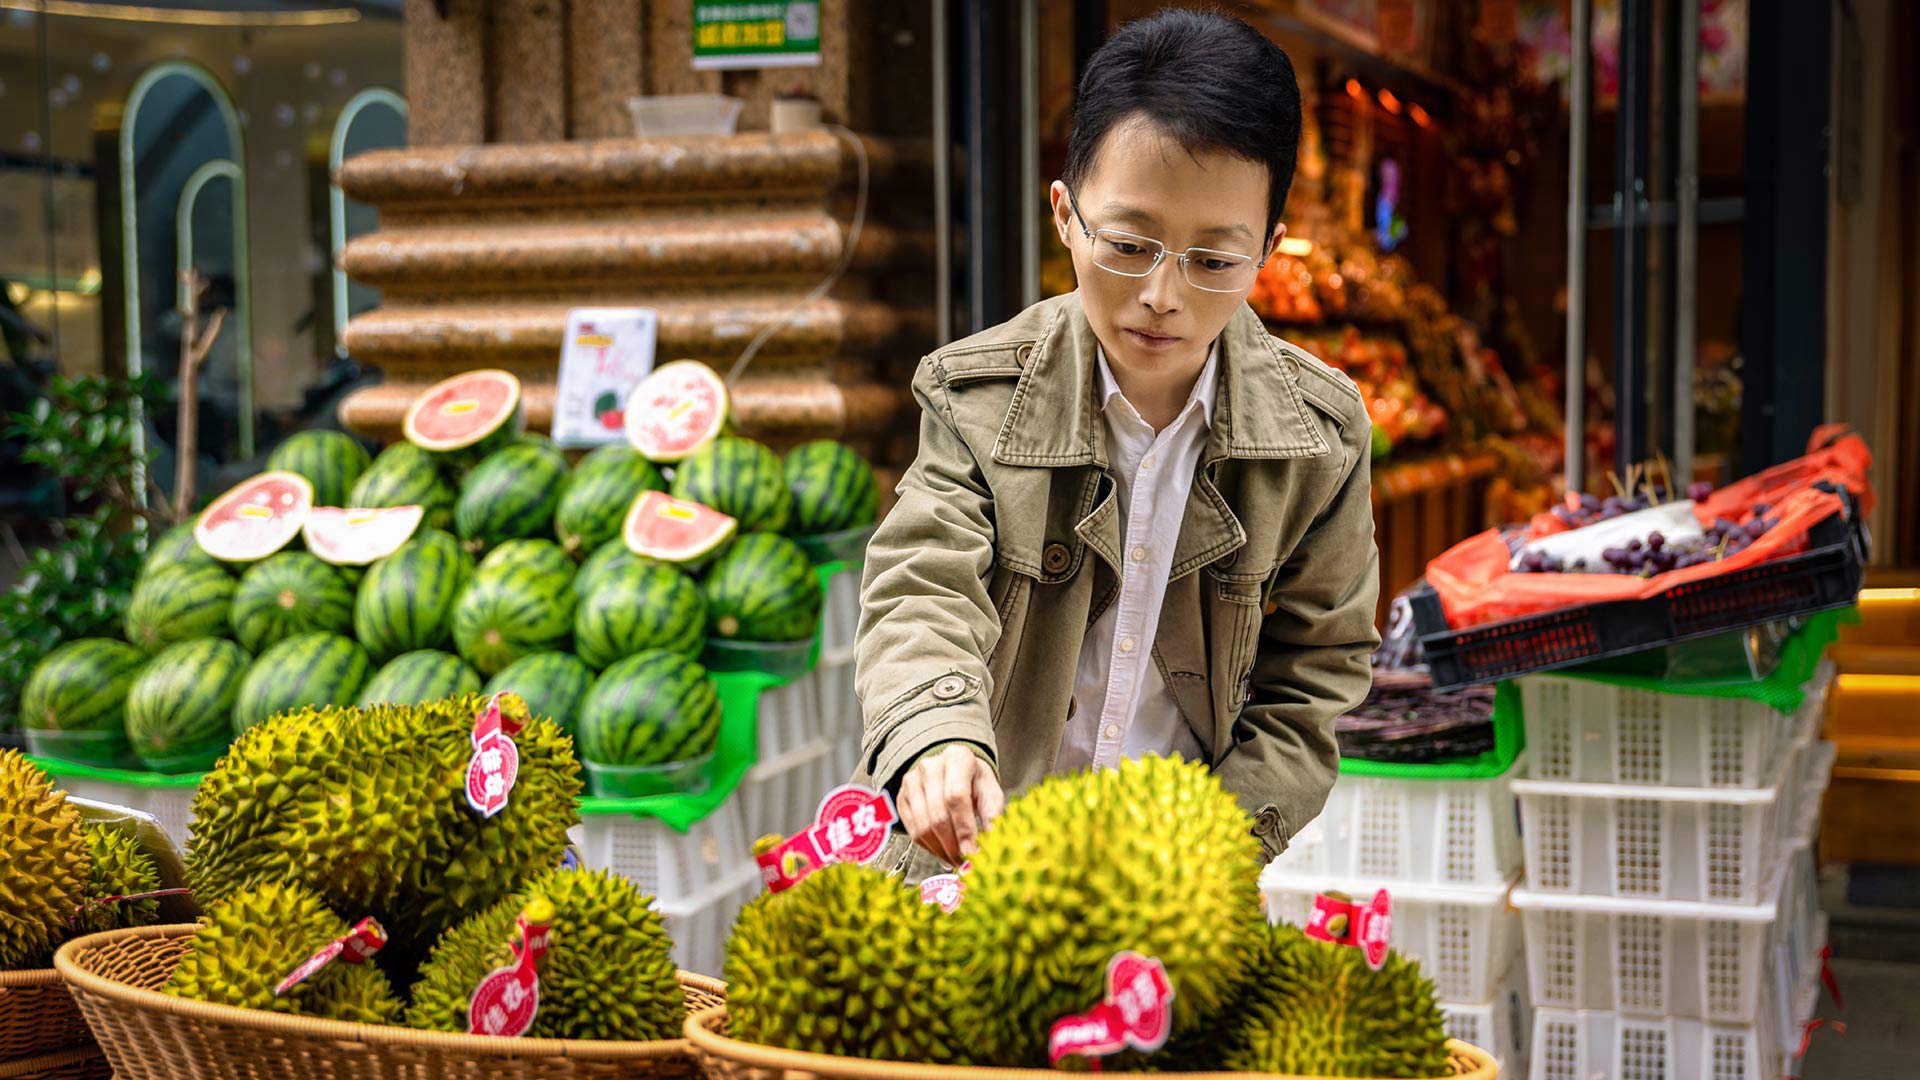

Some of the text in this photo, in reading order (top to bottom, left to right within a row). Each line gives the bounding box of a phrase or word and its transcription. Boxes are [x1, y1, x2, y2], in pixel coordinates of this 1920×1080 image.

[480, 746, 504, 801] 佳农
[825, 803, 882, 850] 佳农
[482, 977, 531, 1035] 佳农
